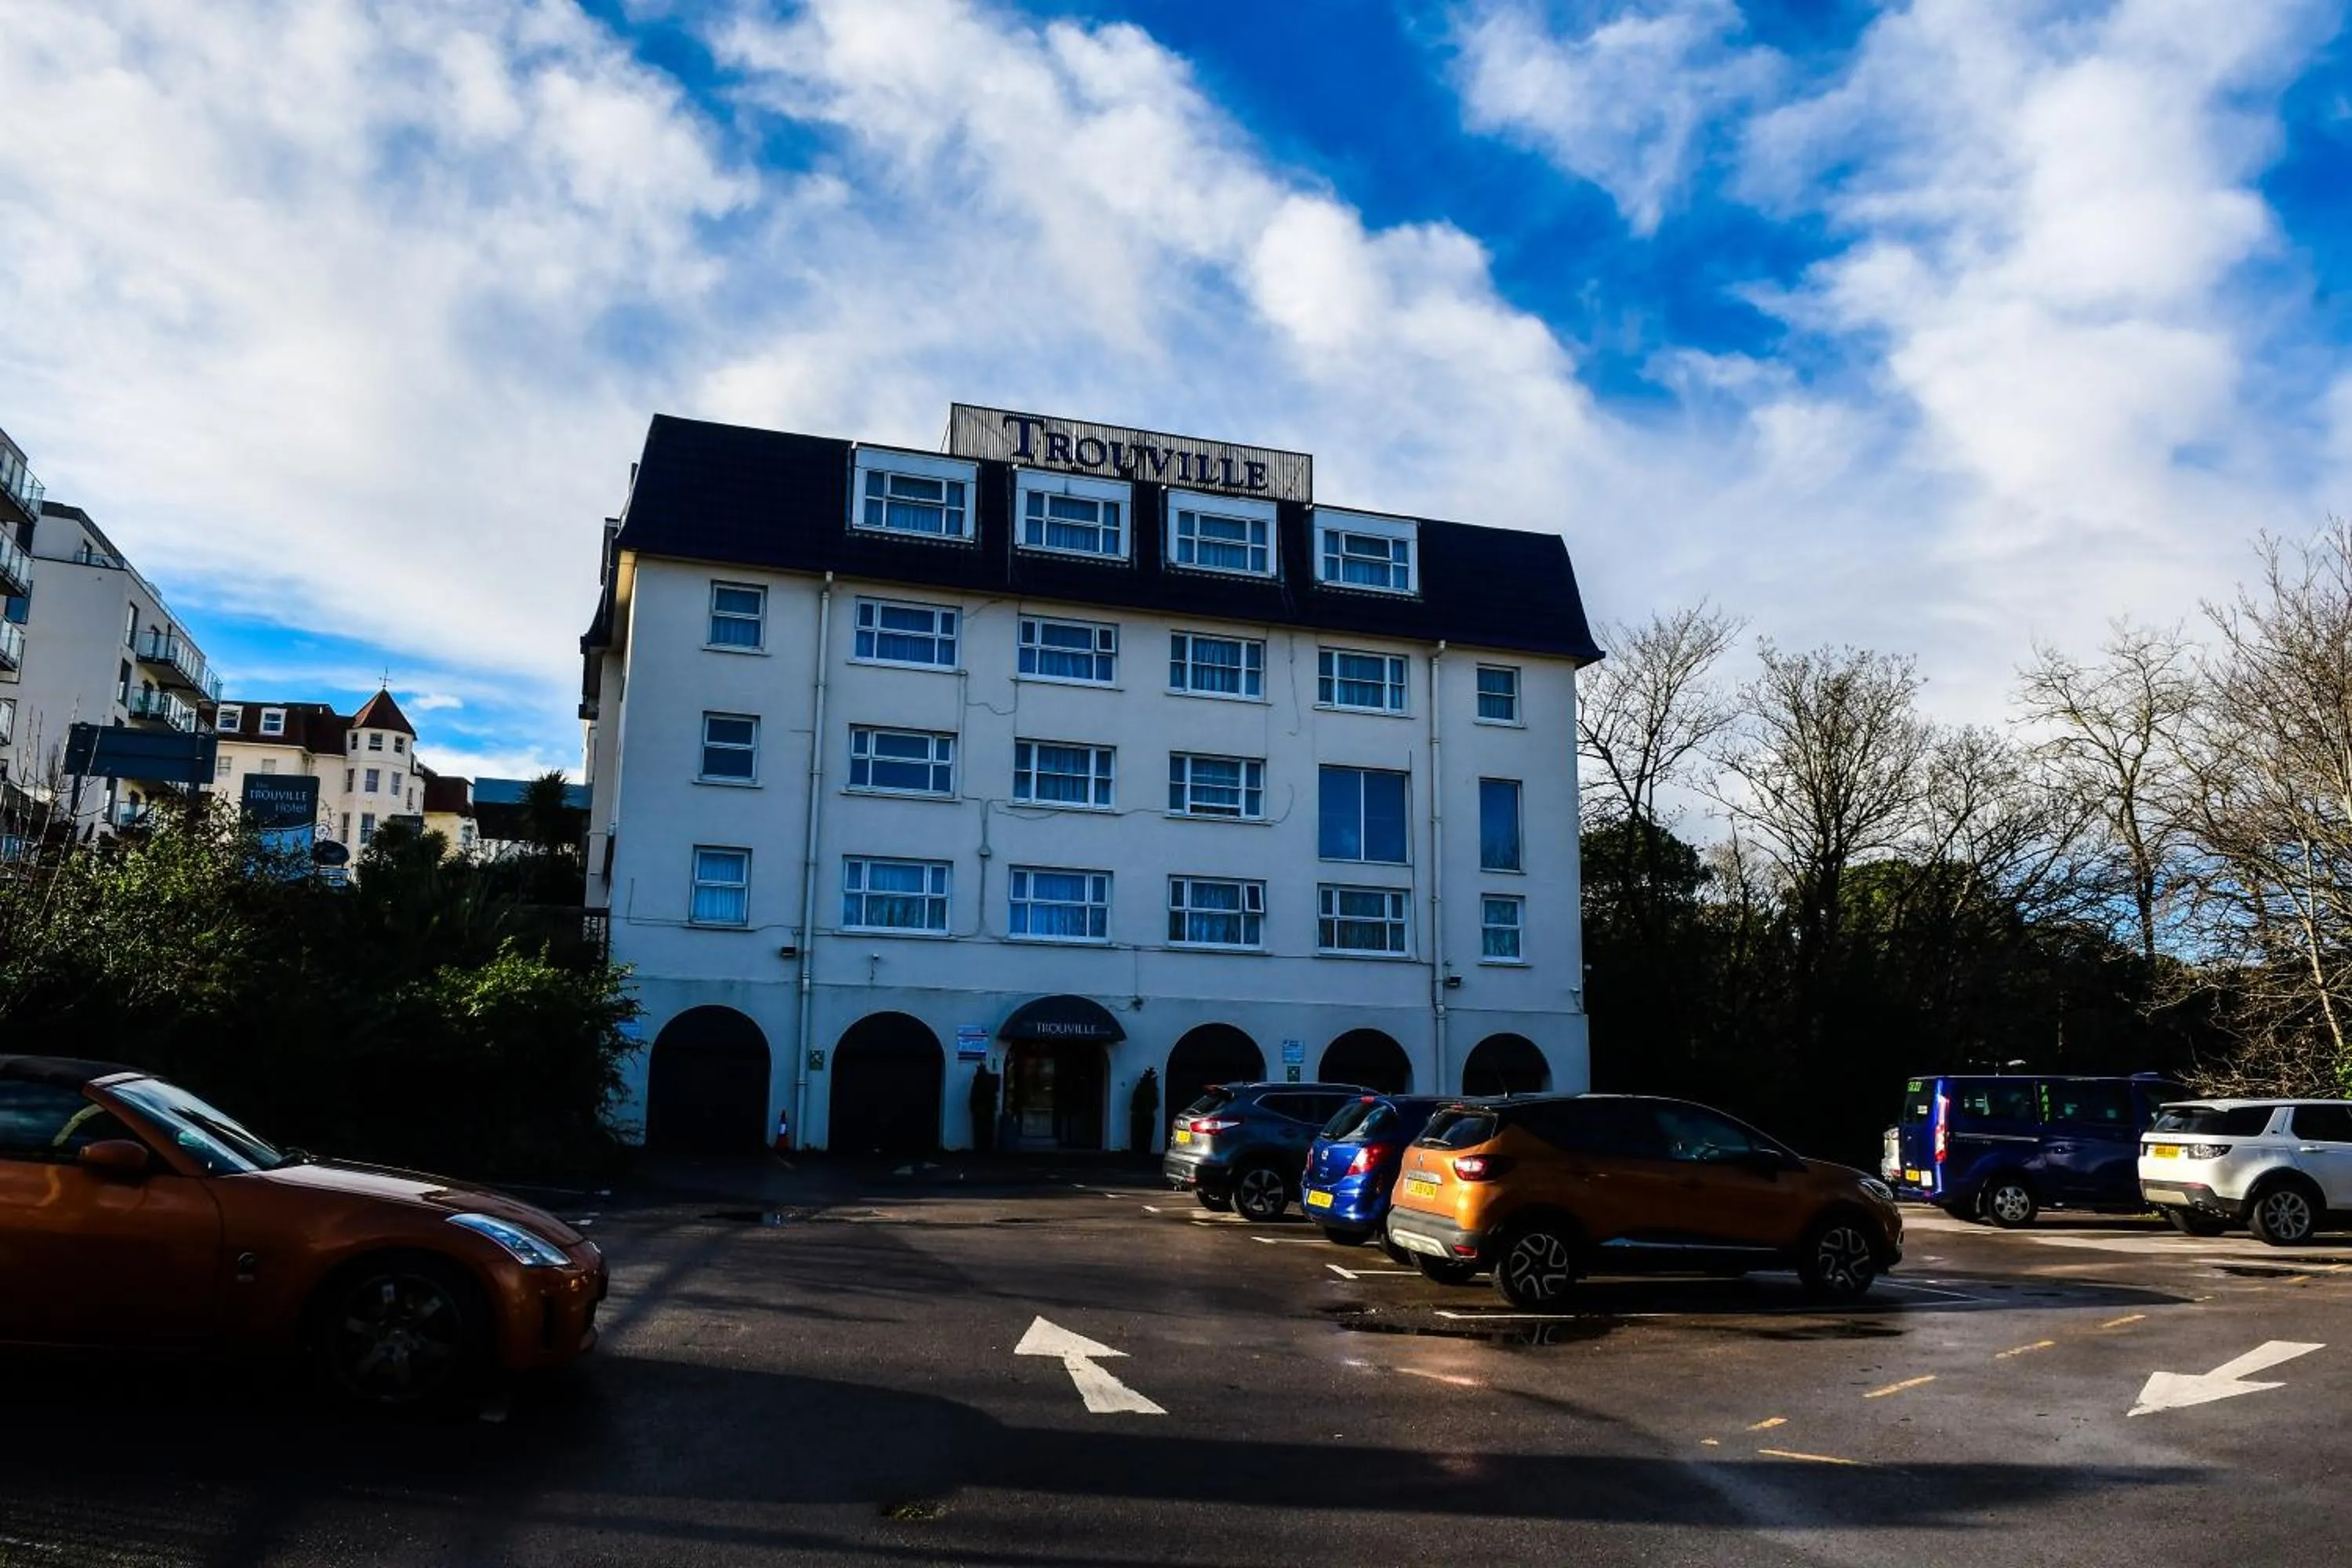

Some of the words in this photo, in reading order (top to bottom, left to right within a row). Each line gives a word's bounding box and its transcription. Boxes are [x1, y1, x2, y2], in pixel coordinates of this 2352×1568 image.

[1004, 416, 1267, 491] TROUVILLE
[249, 789, 308, 800] TROUVILLE
[276, 802, 307, 814] Hotel
[1036, 1022, 1098, 1035] TROUVILLE
